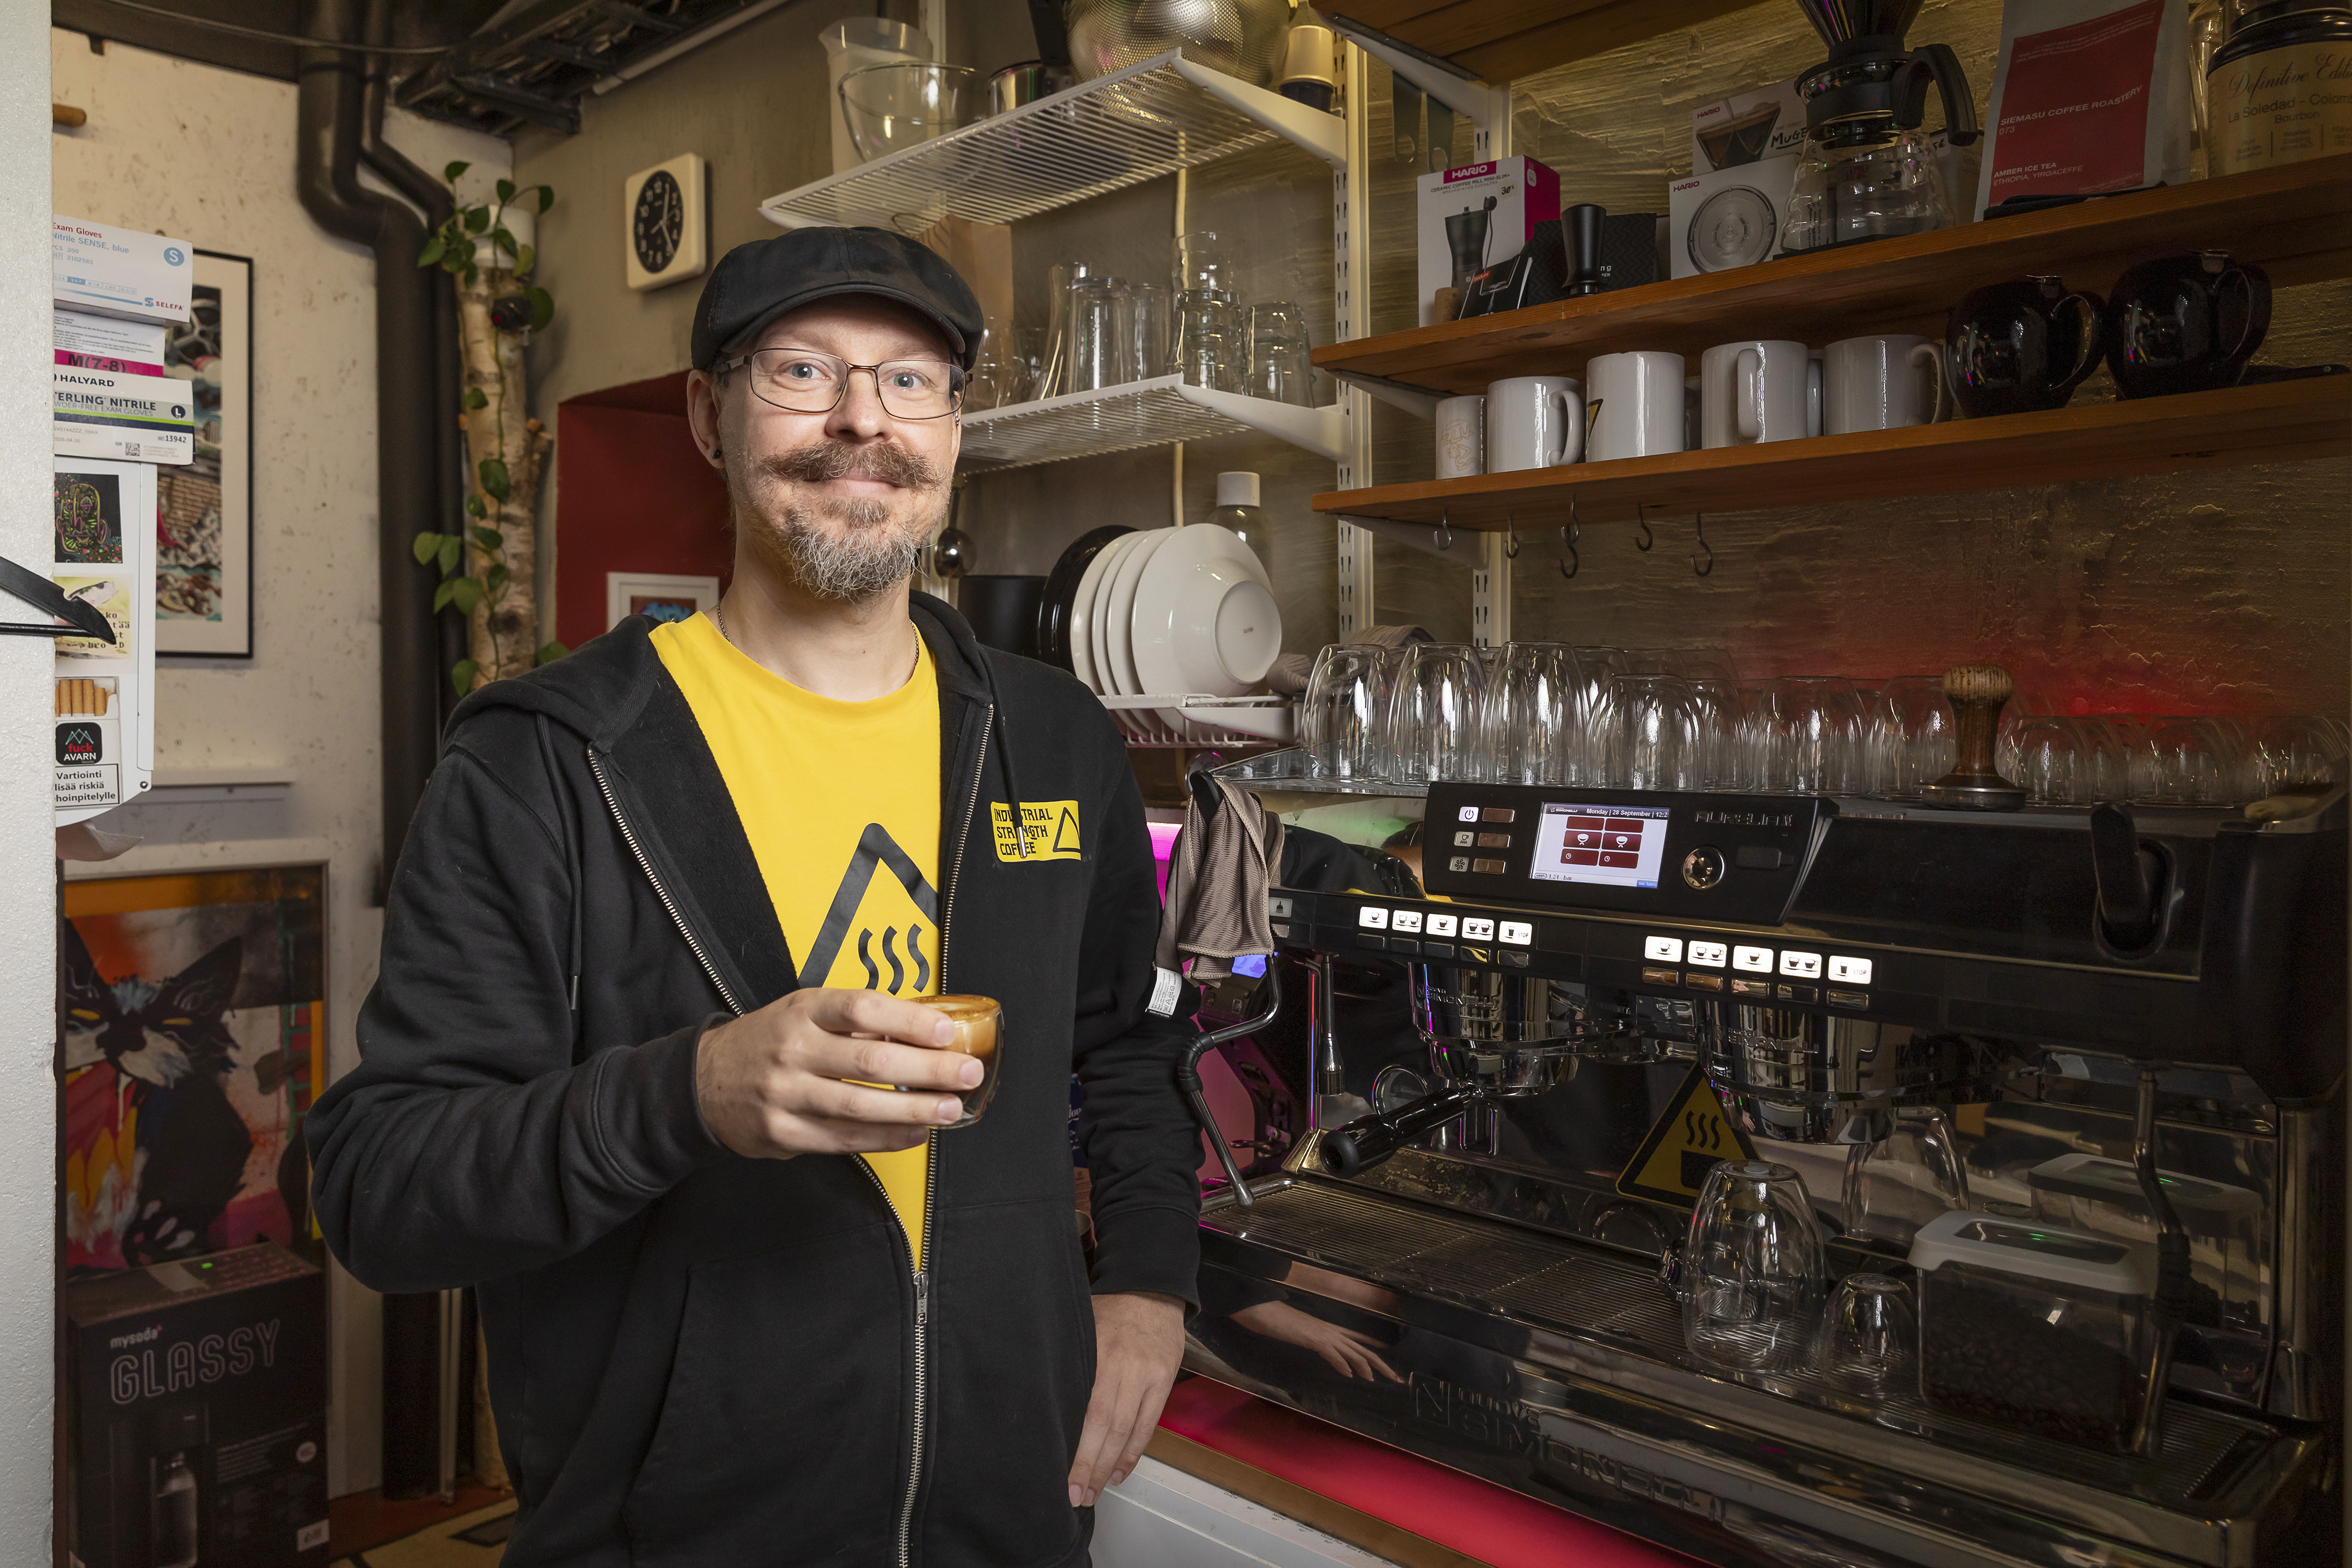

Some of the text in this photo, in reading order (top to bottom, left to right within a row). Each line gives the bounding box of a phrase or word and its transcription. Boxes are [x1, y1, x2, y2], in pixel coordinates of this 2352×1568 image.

[2228, 62, 2309, 103] Definitive
[1999, 85, 2143, 126] SIEMASU COFFEE ROASTERY
[2228, 112, 2240, 123] La
[2243, 97, 2296, 118] Soledad
[1696, 106, 1720, 119] HARIO
[2275, 111, 2319, 124] Bourbon
[1999, 126, 2015, 135] 073
[1452, 165, 1488, 179] HARIO
[1993, 166, 2023, 179] AMBER
[1993, 165, 2083, 187] ETHIOPIA, YIRGACEFFE
[1430, 185, 1452, 193] CERAMIC
[1452, 181, 1471, 189] COFFEE
[1673, 180, 1700, 193] HARIO
[53, 222, 102, 238] Exam Gloves
[53, 232, 130, 253] Nitrile SENSE, blue
[169, 247, 179, 263] S
[155, 301, 184, 311] SELEFA
[68, 354, 126, 373] M(7-8)
[60, 374, 115, 387] HALYARD
[101, 405, 122, 413] EXAM
[124, 408, 153, 417] GLOVES
[110, 398, 156, 411] NITRILE
[175, 407, 182, 415] L
[165, 435, 187, 443] 13942
[68, 743, 93, 752] fuck
[63, 752, 97, 761] AVARN
[56, 770, 102, 779] Vartiointi
[55, 781, 105, 791] lisää riskiä
[1695, 811, 1779, 826] AURELIA
[997, 825, 1049, 840] STRNGTH
[1000, 841, 1036, 856] COFEE
[109, 1328, 159, 1350] mysoda
[110, 1318, 281, 1405] GLASSY
